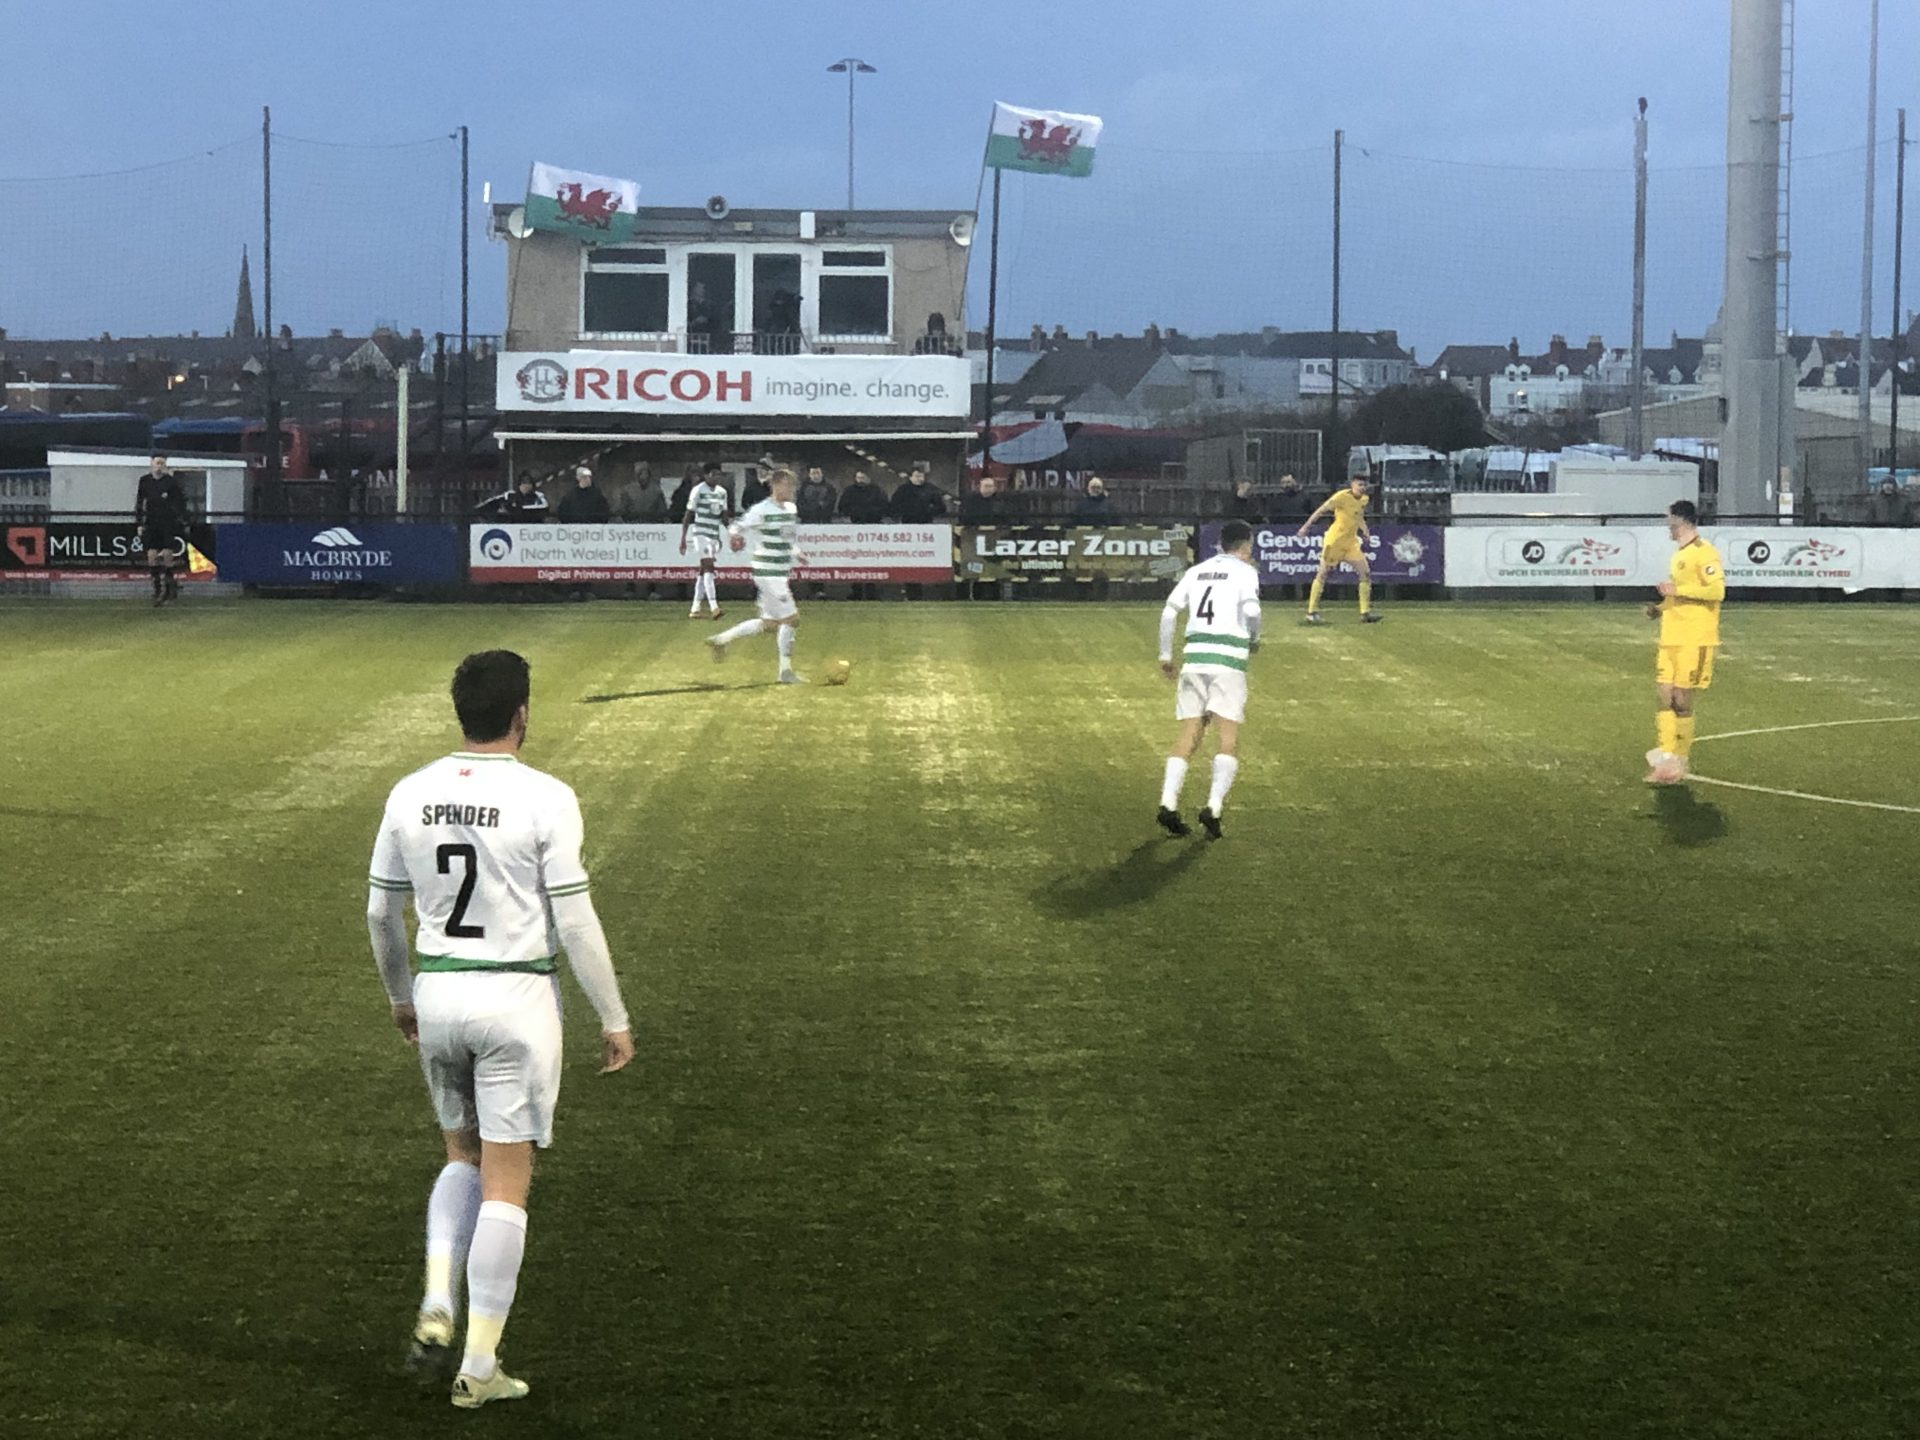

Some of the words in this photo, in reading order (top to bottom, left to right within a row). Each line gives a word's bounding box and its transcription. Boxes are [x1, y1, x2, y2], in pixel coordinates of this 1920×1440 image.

[574, 367, 752, 402] RICOH
[765, 376, 858, 401] imagine.
[865, 377, 950, 403] change.
[519, 528, 552, 542] Euro
[556, 527, 604, 545] Digital
[608, 528, 667, 545] Systems
[856, 532, 890, 543] 01745
[893, 532, 912, 543] 582
[50, 535, 128, 557] MILLS
[130, 535, 144, 552] &
[976, 534, 1076, 556] Lazer
[1083, 534, 1171, 556] Zone
[283, 550, 393, 567] MACBRYDE
[520, 547, 566, 563] (North
[570, 547, 620, 563] Wales)
[625, 548, 652, 561] Ltd.
[1260, 550, 1305, 561] Indoor
[311, 570, 363, 581] HOMES
[537, 569, 571, 581] Digital
[574, 569, 610, 580] Printers
[614, 569, 634, 580] and
[801, 570, 831, 580] Wales
[834, 570, 889, 580] Businesses
[1269, 561, 1323, 575] Playzon
[1196, 585, 1214, 625] 4
[422, 804, 501, 828] SPENDER
[436, 843, 485, 939] 2
